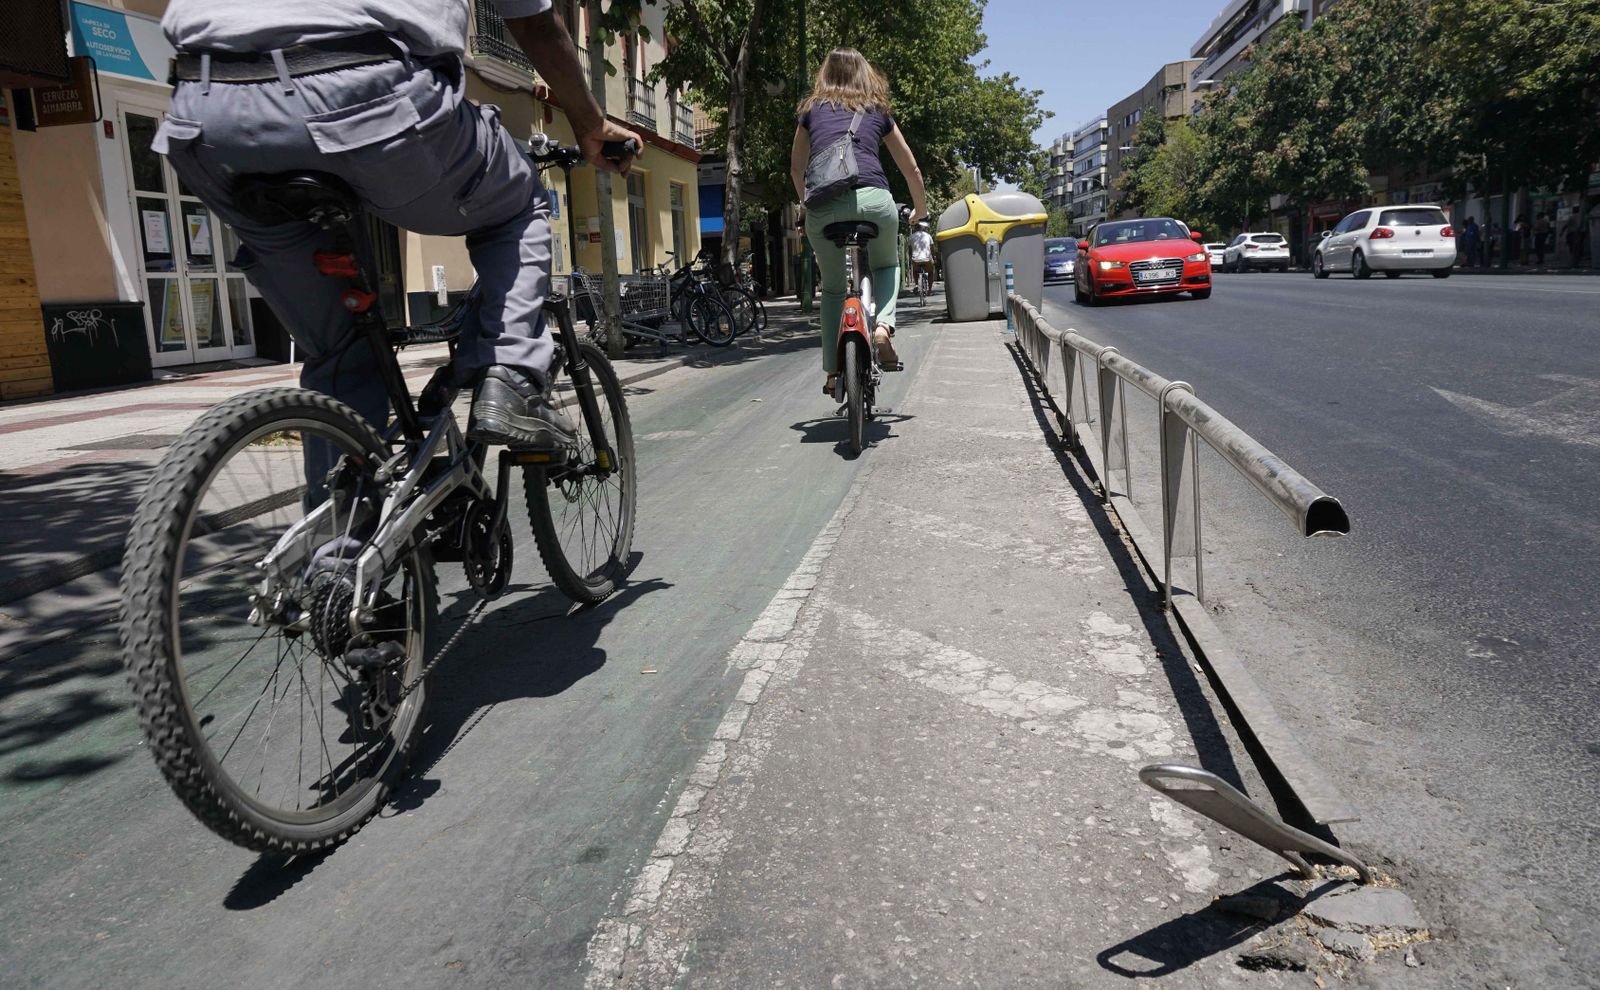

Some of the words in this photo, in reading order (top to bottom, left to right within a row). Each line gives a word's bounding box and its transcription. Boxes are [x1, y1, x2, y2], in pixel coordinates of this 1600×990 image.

[92, 26, 116, 40] SECO
[86, 41, 131, 56] AUTOSERVICIO
[42, 89, 79, 102] CERVEZAS
[42, 101, 83, 114] ALHAMBRA
